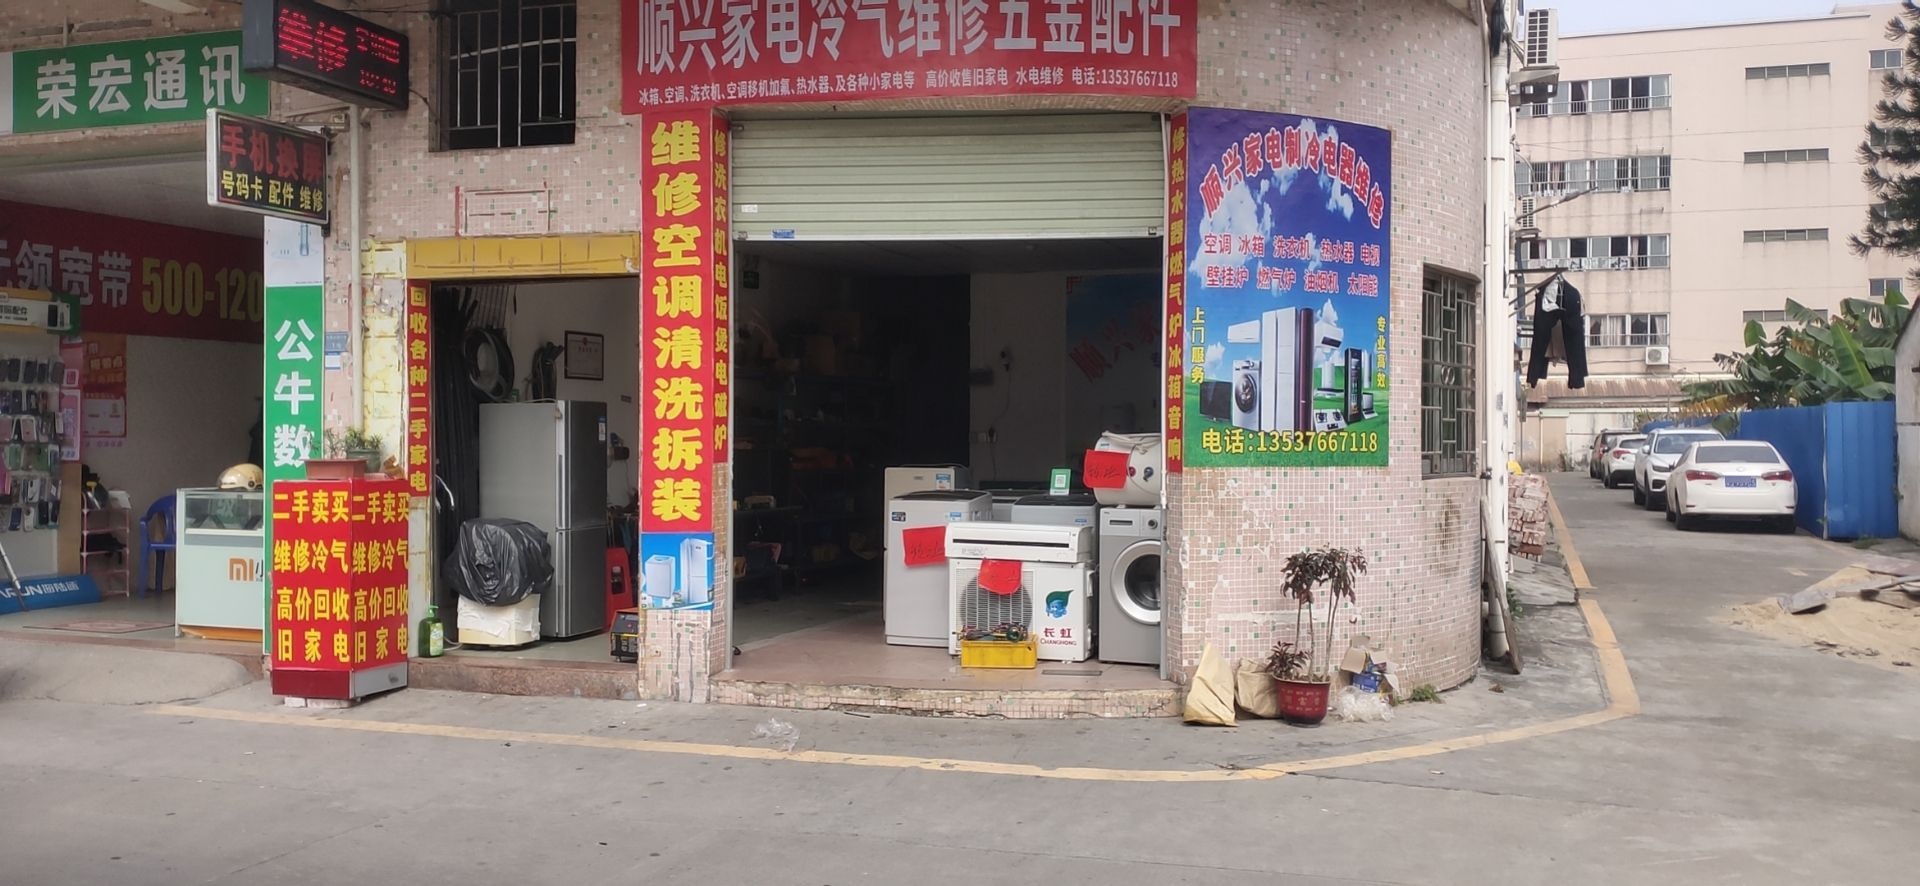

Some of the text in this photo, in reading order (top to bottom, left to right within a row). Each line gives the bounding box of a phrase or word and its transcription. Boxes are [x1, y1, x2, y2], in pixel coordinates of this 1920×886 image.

[637, 0, 1181, 77] 顺兴家电冷气维修五金配件
[36, 44, 246, 119] 荣宏通讯
[926, 68, 1008, 89] 高价收售旧家电
[1016, 67, 1064, 87] 水电维修
[1072, 67, 1178, 88] 电话:13537667118
[221, 125, 324, 182] 手机换屏
[221, 170, 324, 213] 号码卡 配件 维修
[1200, 125, 1384, 229] 顺兴家电制冷电器维修
[1204, 233, 1380, 266] 空调 冰箱 洗衣机 热水器 电视
[0, 240, 132, 308] 领宽带
[714, 129, 728, 450] 修洗衣机电饭煲电磁炉
[1168, 126, 1187, 461] 修热水器燃气炉冰箱音响
[1206, 266, 1379, 297] 壁挂炉 燃气炉 油烟机 太阳能
[652, 120, 703, 523] 维修空调清洗拆装
[1191, 307, 1206, 384] 上门服务
[1376, 316, 1387, 389] 专业高效
[274, 318, 316, 468] 公牛数
[408, 285, 428, 493] 回收各种二手家电
[1202, 429, 1378, 454] 电话:13537667118
[272, 490, 349, 524] 二手卖买
[352, 491, 410, 525] 二手卖买
[273, 538, 350, 575] 维修冷气
[352, 537, 410, 576] 维修冷气
[276, 586, 350, 623] 高价回收
[354, 583, 410, 623] 高价回收
[277, 628, 350, 663] 旧家电
[353, 624, 409, 664] 旧家电
[1040, 637, 1077, 646] CHANGHONG
[1044, 628, 1072, 638] 长虹
